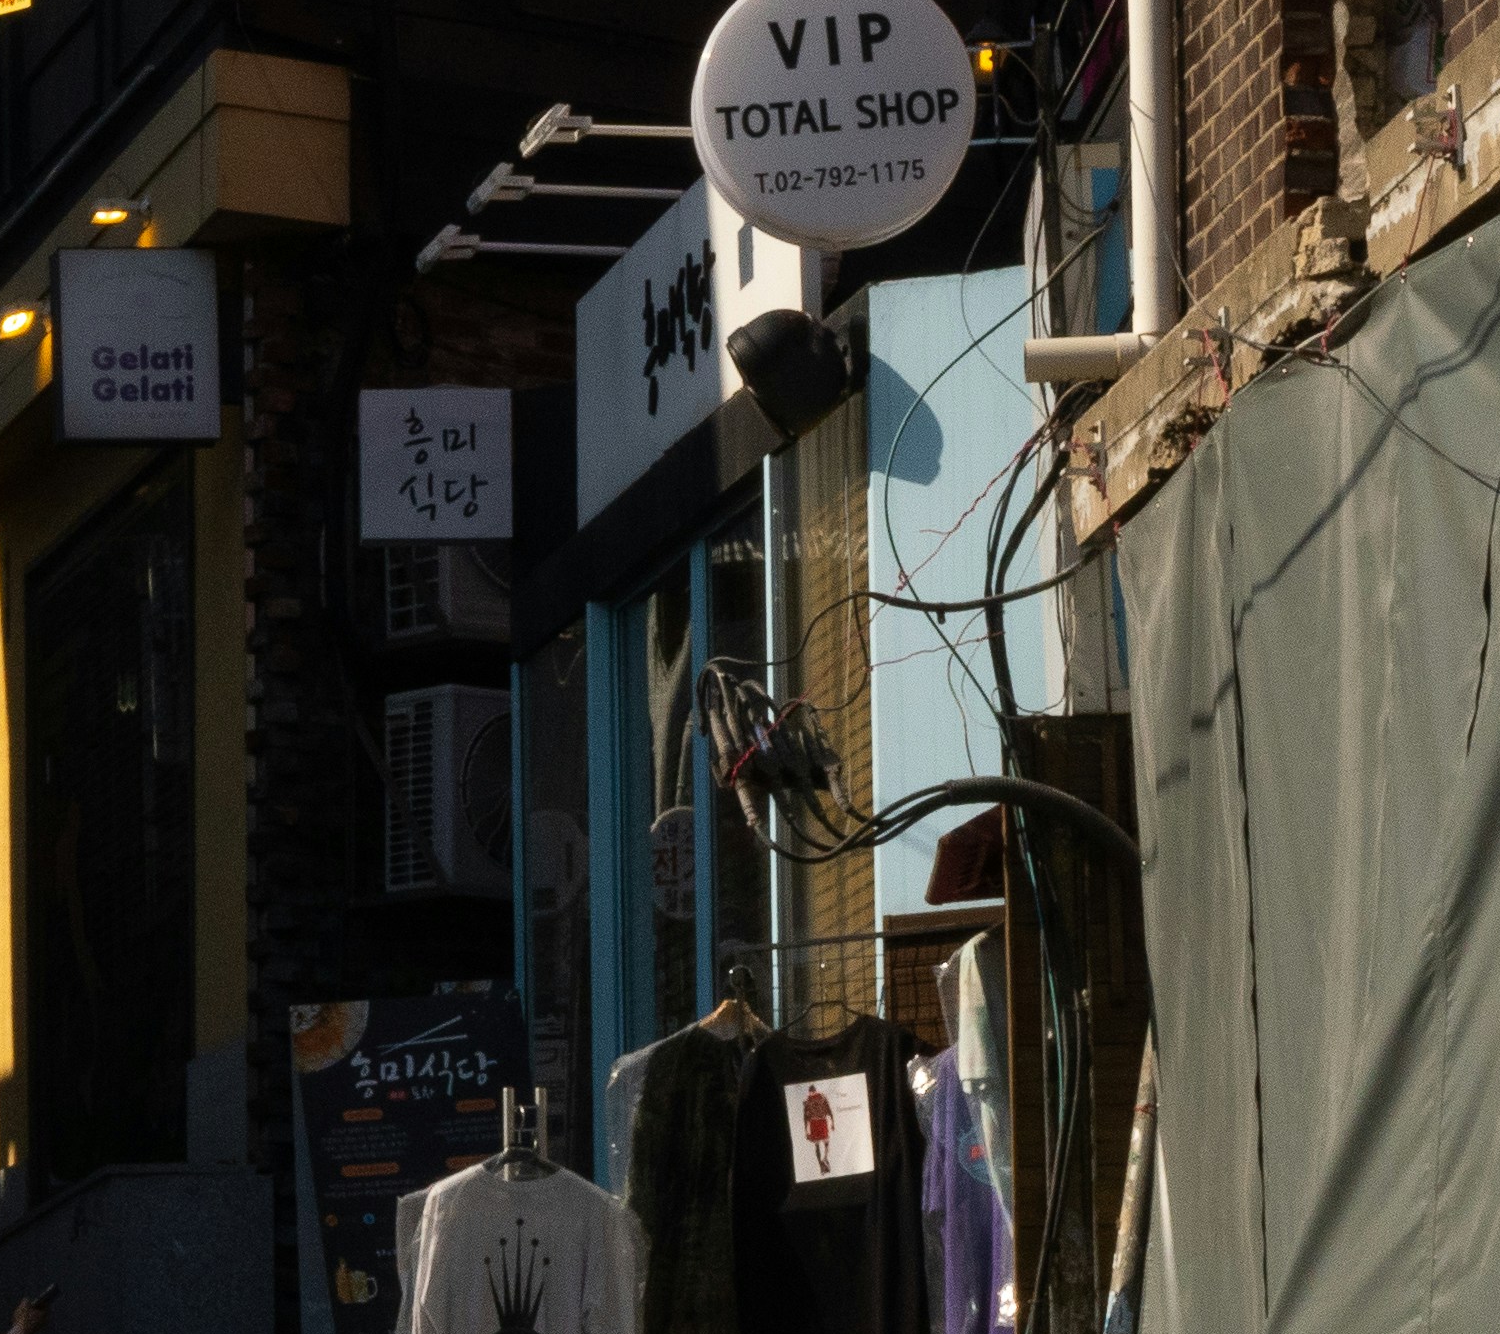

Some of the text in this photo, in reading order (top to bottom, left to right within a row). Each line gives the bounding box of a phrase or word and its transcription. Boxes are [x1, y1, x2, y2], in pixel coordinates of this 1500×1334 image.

[767, 12, 892, 70] VIP
[715, 87, 960, 141] TOTAL SHOP
[754, 158, 926, 196] T.02-792-1175
[92, 343, 194, 371] Gelati
[92, 374, 195, 403] Gelati
[403, 407, 477, 465] 흥미
[398, 471, 489, 521] 식당
[350, 1050, 498, 1099] 흥미식당
